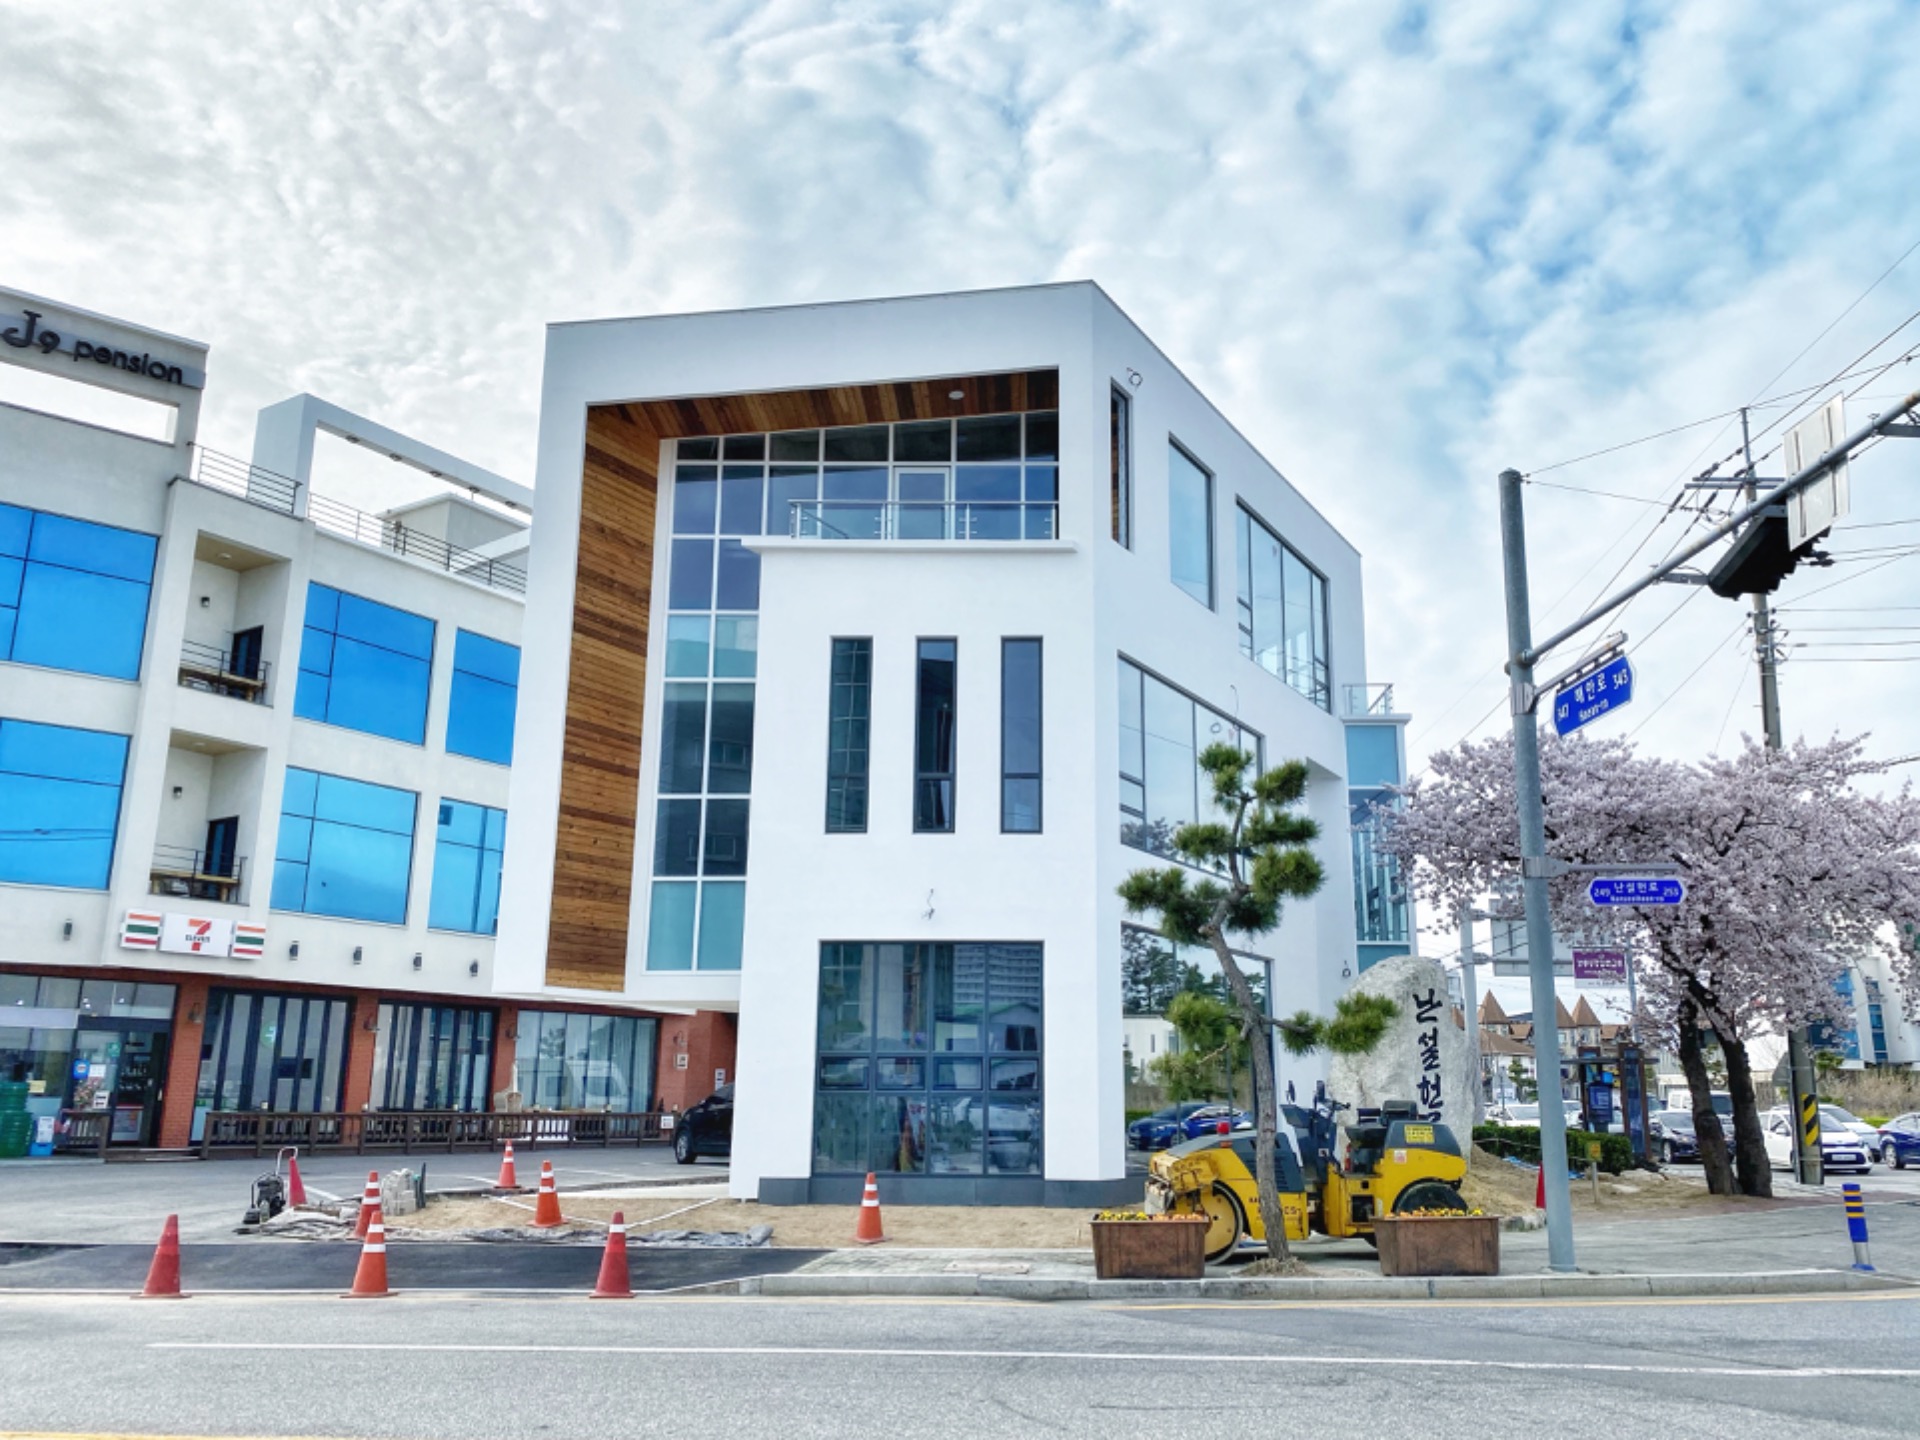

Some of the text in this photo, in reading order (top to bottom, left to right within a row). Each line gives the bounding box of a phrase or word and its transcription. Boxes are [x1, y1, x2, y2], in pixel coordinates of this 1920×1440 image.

[2, 309, 183, 384] J9 pension
[1574, 672, 1607, 703] 해안로
[1613, 882, 1659, 893] 난설헌로
[188, 918, 212, 951] 7
